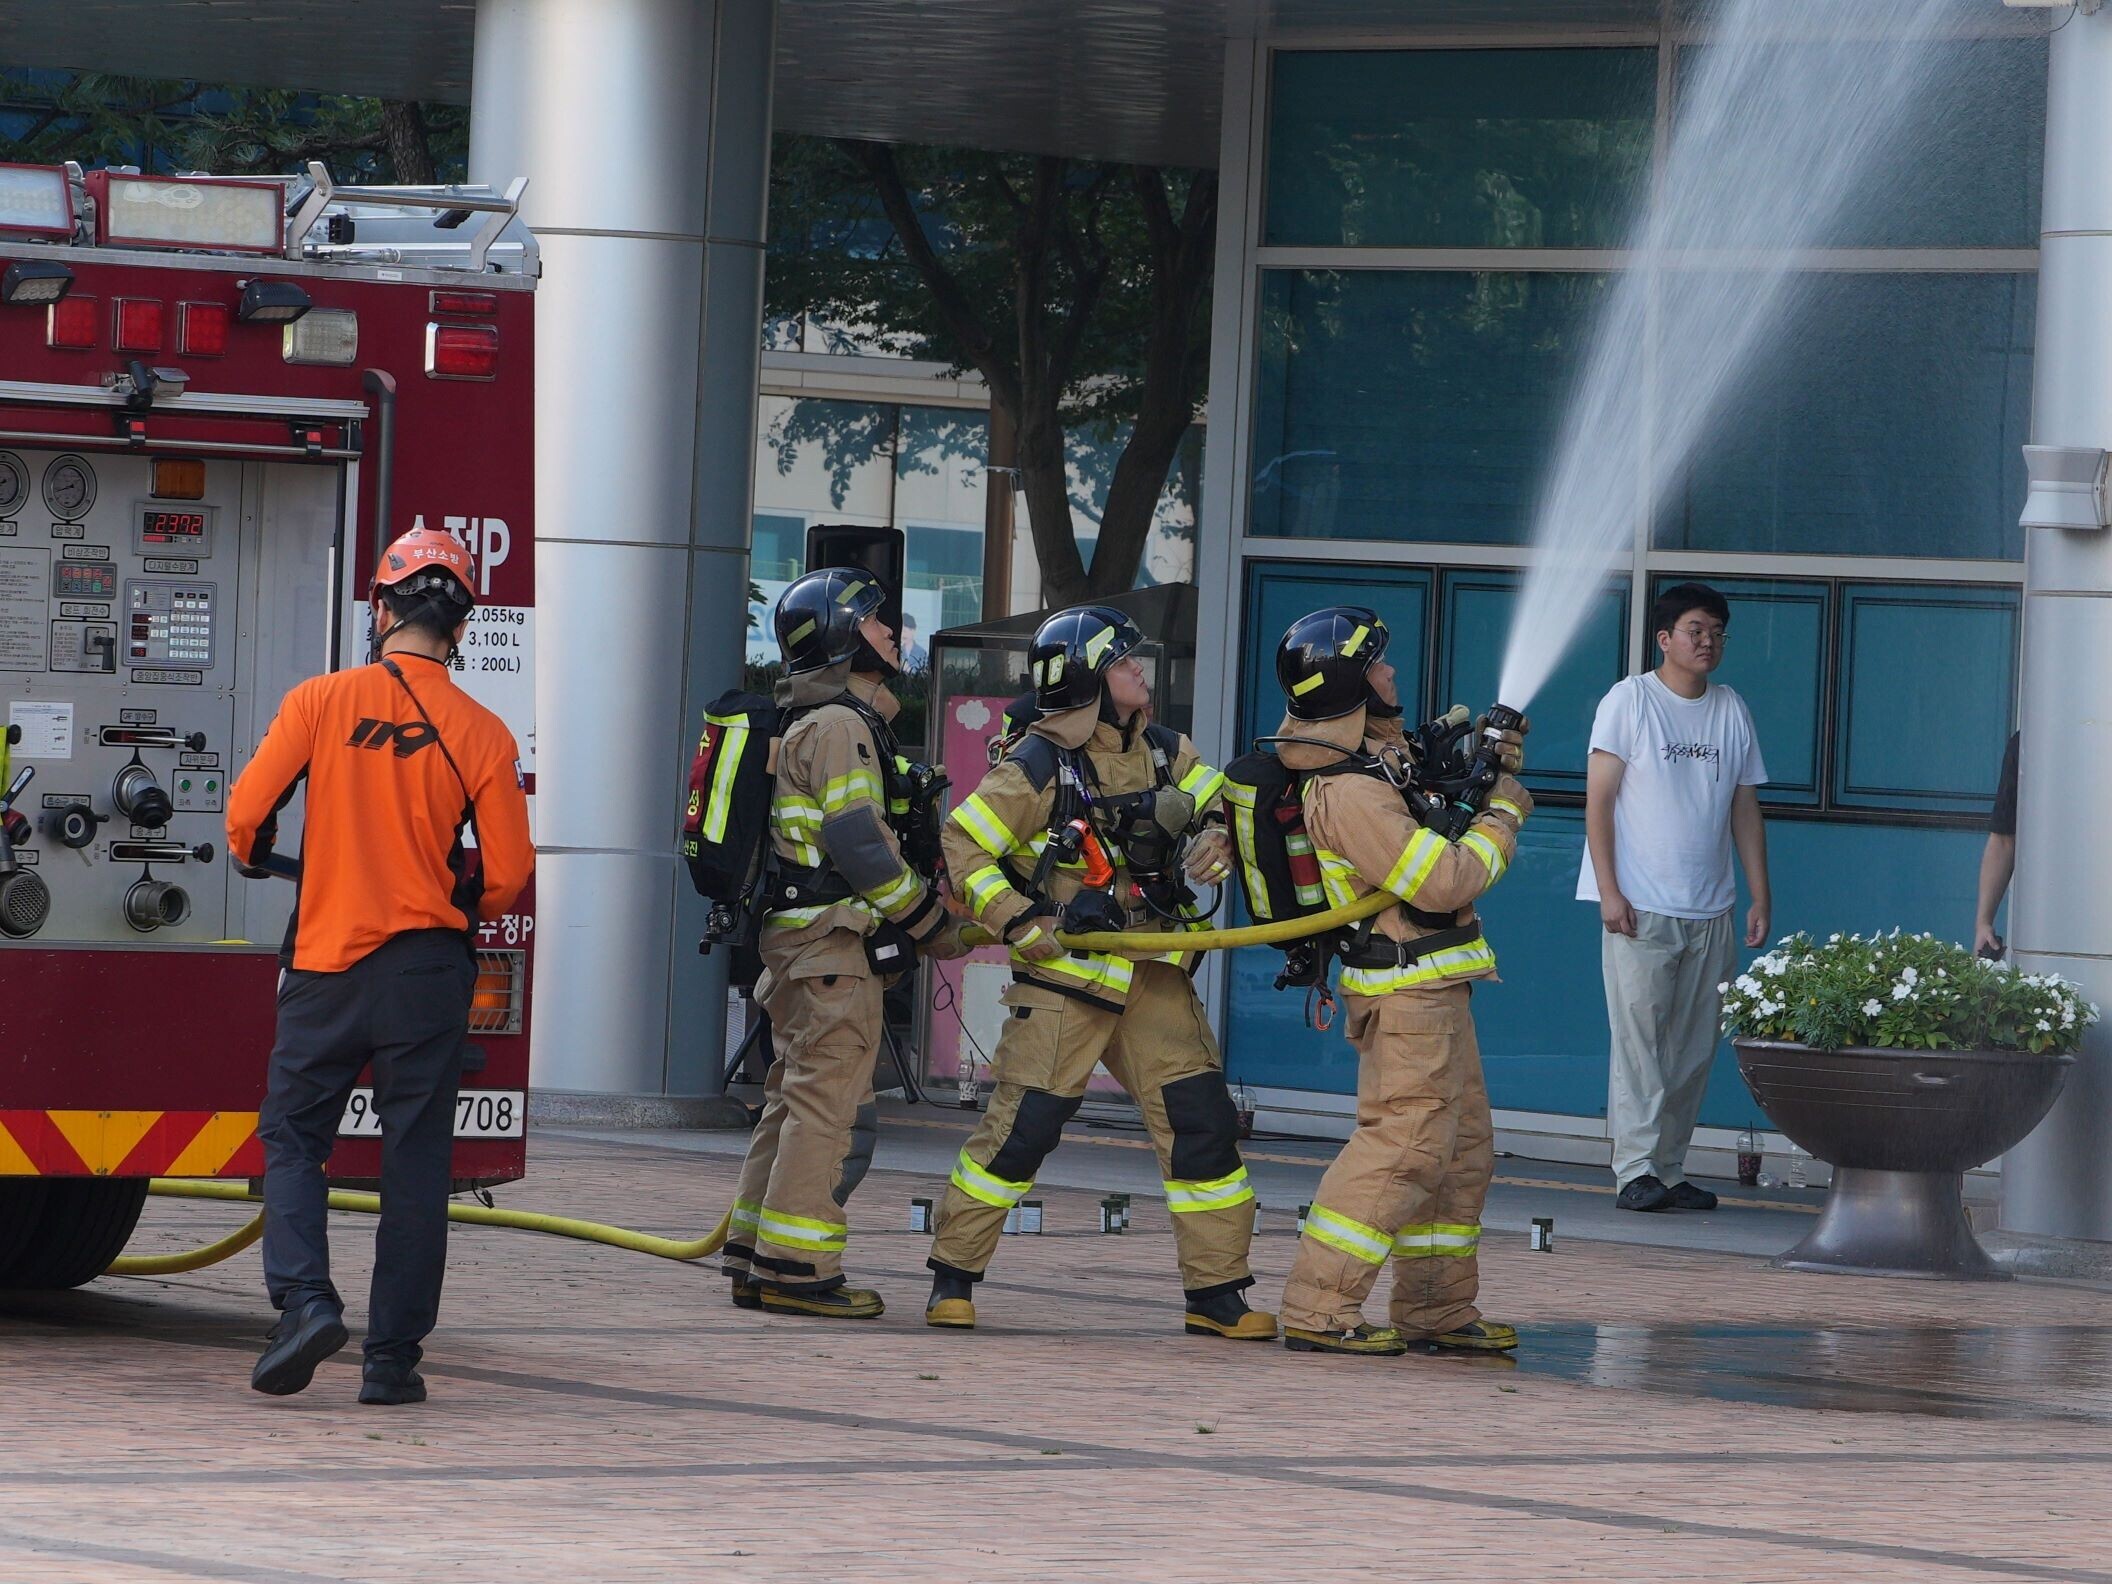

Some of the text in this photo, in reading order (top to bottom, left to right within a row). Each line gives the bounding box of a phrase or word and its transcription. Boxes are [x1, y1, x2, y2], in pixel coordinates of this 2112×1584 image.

[56, 526, 82, 537] 압력계
[155, 514, 202, 535] 2372
[67, 547, 107, 558] 비상조작반
[412, 548, 460, 565] 부산소방
[468, 631, 520, 648] 3,100 L
[481, 656, 521, 674] 200L)
[345, 718, 439, 759] 119
